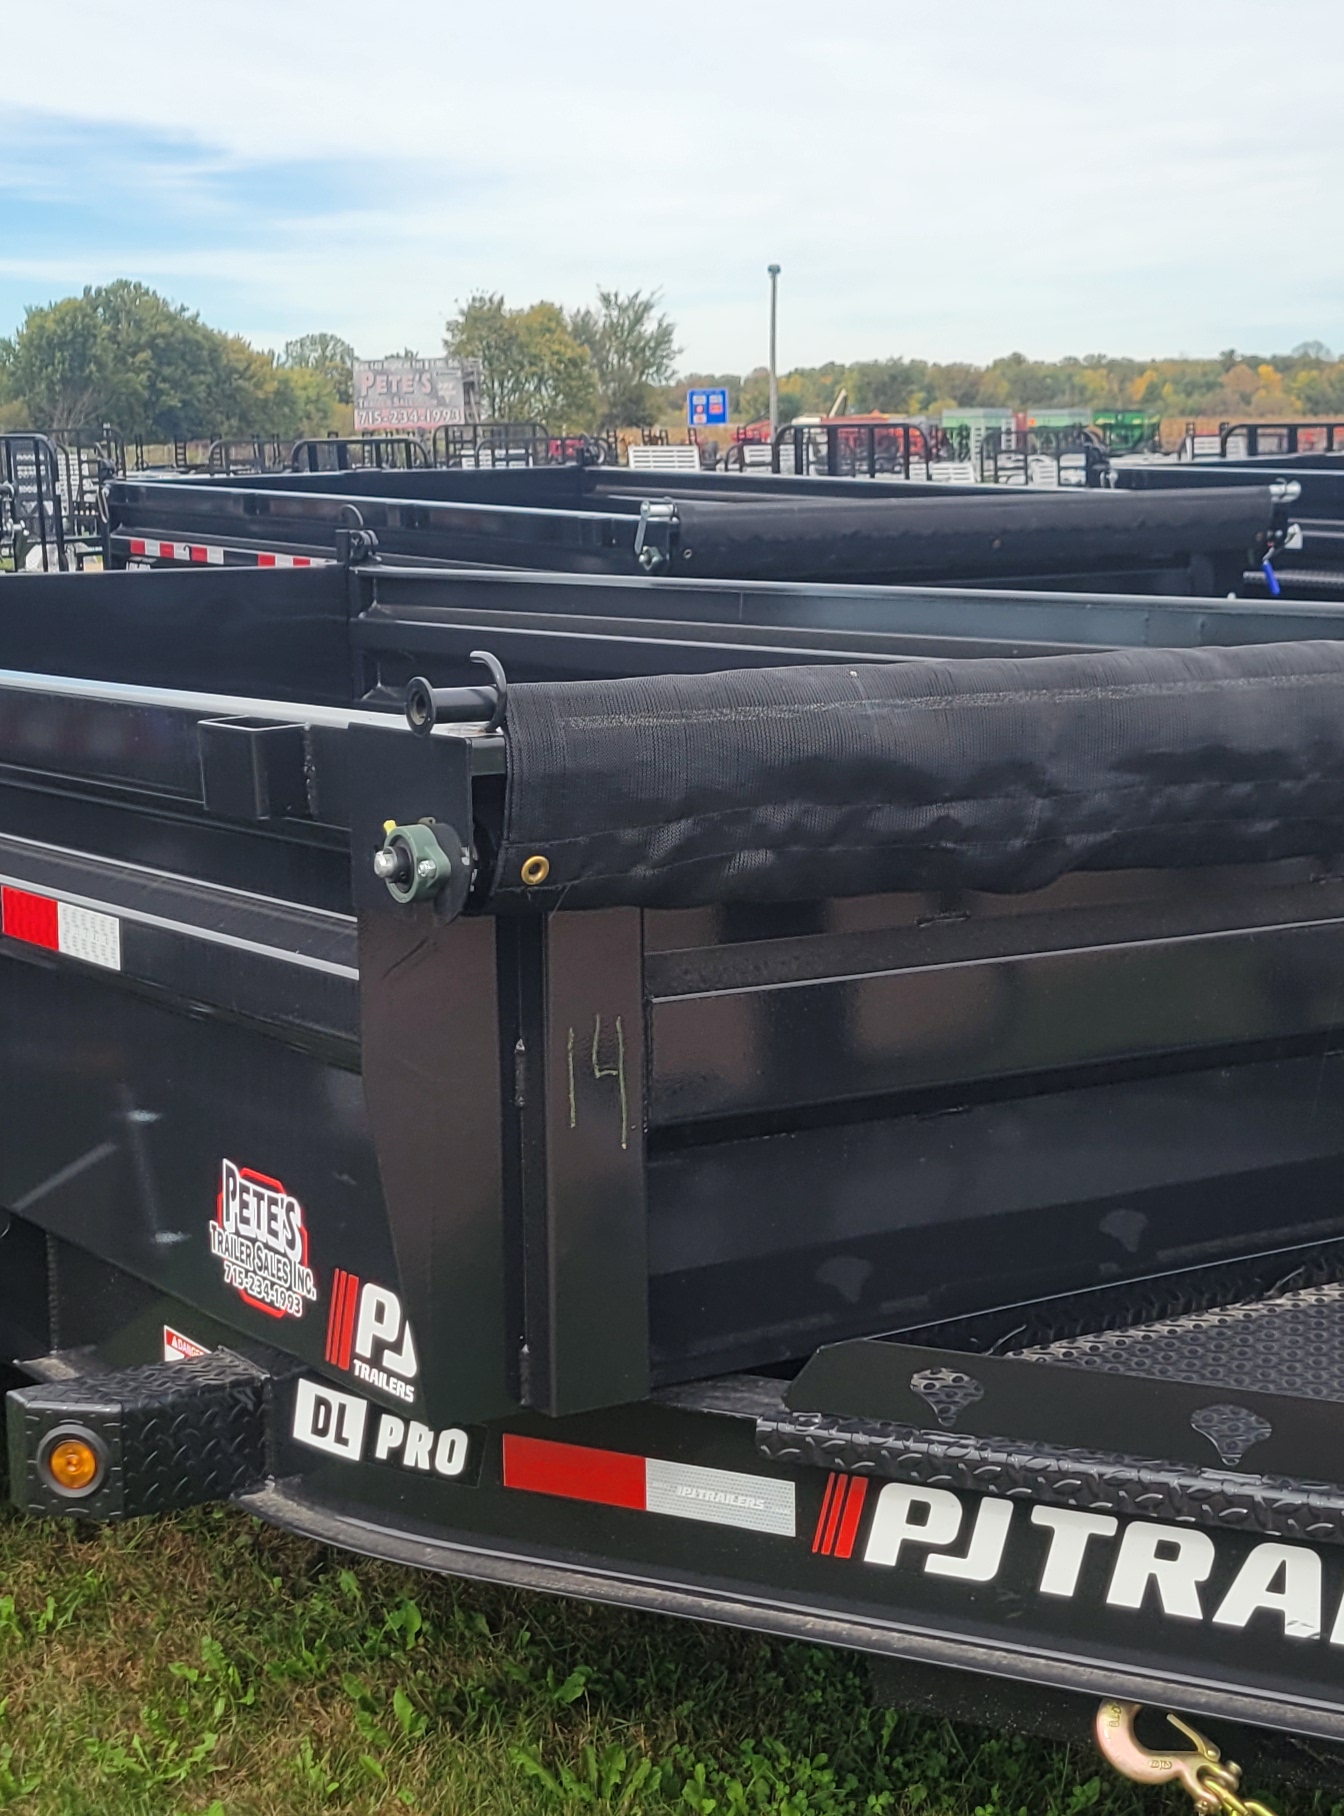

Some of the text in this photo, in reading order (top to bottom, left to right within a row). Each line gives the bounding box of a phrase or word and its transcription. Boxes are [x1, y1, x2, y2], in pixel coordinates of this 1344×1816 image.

[359, 409, 460, 426] 715-234-1993
[360, 370, 433, 398] PETE'S
[567, 1013, 628, 1150] 14
[222, 1159, 302, 1262] PETE'S
[210, 1220, 317, 1301] TRAILER SALES INC.
[224, 1261, 303, 1317] 715-234-1993
[353, 1359, 415, 1403] TRAILERS
[310, 1393, 468, 1475] DL PRO
